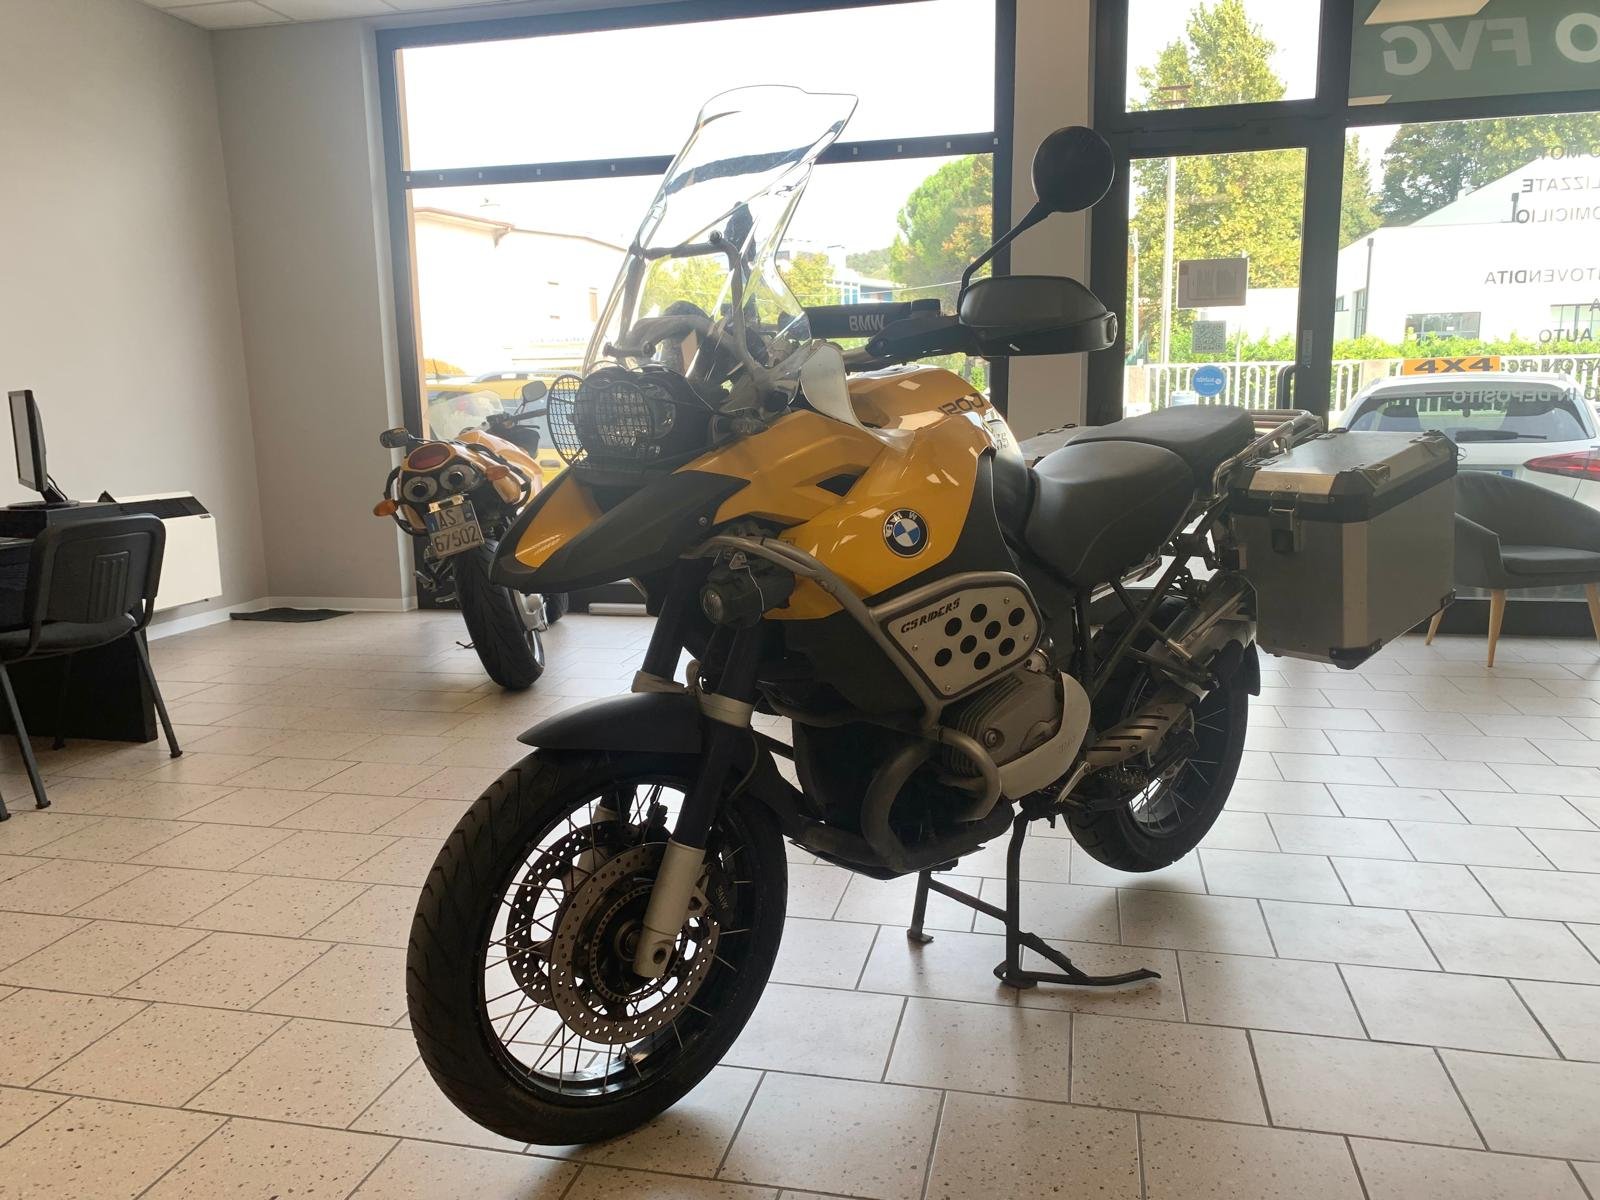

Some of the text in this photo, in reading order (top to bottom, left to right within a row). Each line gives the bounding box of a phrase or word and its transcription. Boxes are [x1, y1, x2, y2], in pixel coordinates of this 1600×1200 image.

[849, 314, 886, 331] BMW
[938, 392, 984, 416] 1200
[438, 509, 457, 529] AS
[885, 511, 918, 538] BMW
[434, 525, 479, 552] 67502
